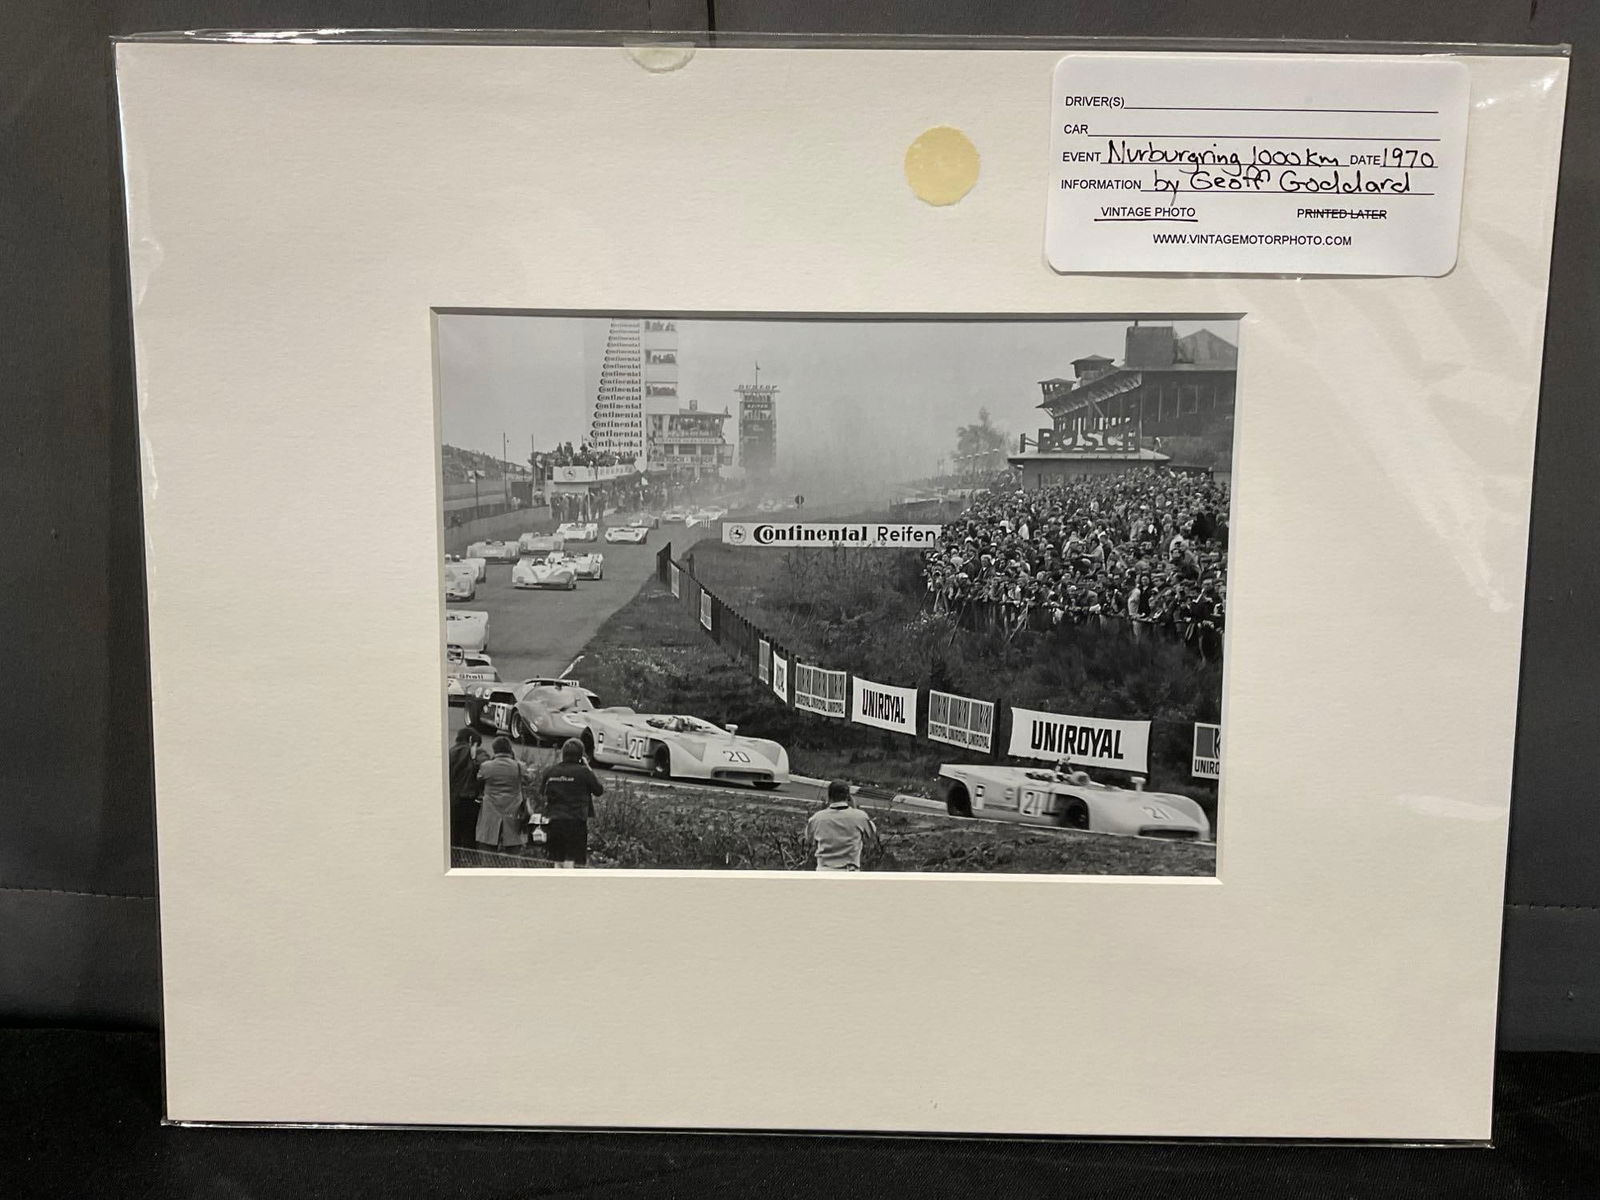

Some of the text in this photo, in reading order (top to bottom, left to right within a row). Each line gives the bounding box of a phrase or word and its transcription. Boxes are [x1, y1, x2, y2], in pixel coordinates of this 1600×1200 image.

[1065, 96, 1125, 109] DRIVER(S)
[1064, 124, 1089, 134] CAR
[1062, 152, 1101, 162] EVENT
[1108, 140, 1242, 176] Nurburgring
[1350, 155, 1381, 165] DATE
[1383, 147, 1434, 168] 1970
[1061, 164, 1410, 206] INFORMATION by Geoff Goddard
[1101, 207, 1196, 217] VINTAGE PHOTO
[1297, 208, 1387, 219] PRINTED LATER
[1153, 234, 1352, 245] WWW.VINTAGEMOTORPHOTO.COM
[593, 411, 641, 419] Continental
[592, 419, 642, 428] Continental
[590, 429, 642, 438] Continental
[1038, 428, 1140, 453] BOSCH
[753, 525, 937, 545] Continental Reifen
[862, 688, 906, 724] UNIROYAL
[1031, 719, 1124, 760] UNIROYAL
[628, 738, 644, 760] 20
[722, 750, 750, 763] 20
[1022, 791, 1040, 816] 21
[1143, 806, 1172, 820] 21
